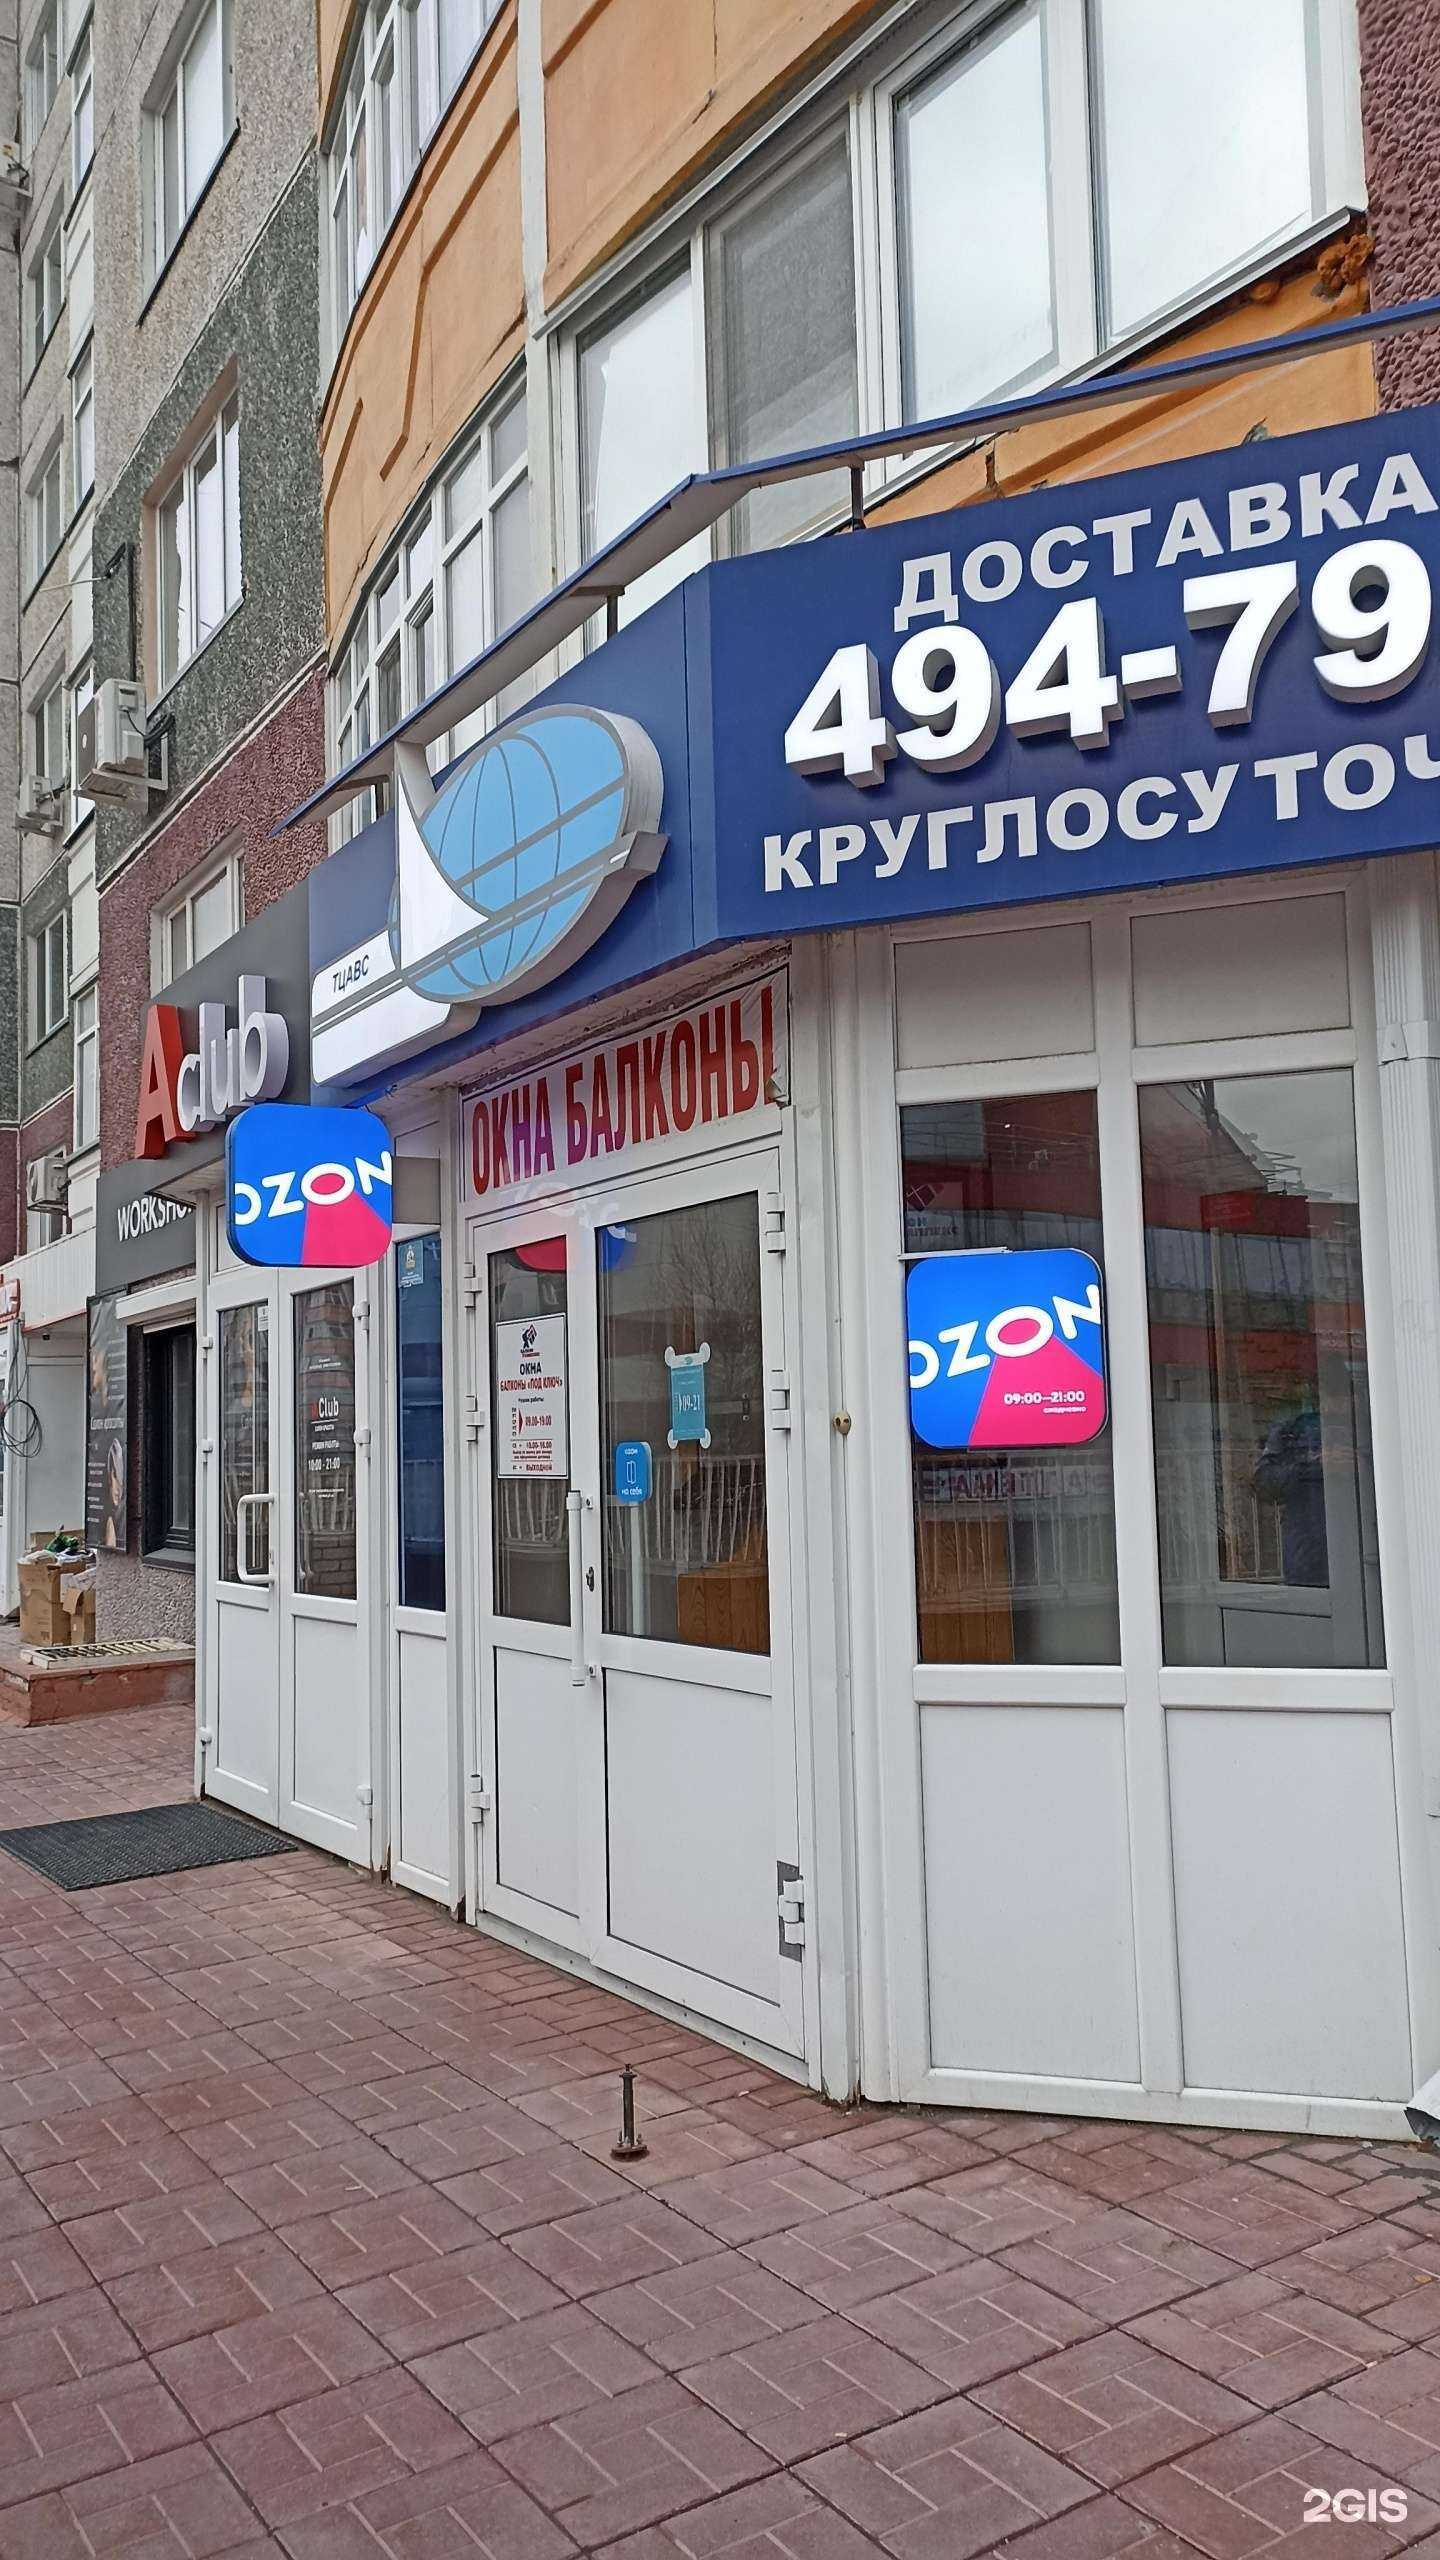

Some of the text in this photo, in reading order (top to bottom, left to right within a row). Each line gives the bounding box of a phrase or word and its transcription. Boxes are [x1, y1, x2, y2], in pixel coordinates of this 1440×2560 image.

[894, 453, 1439, 632] ДОСТАВКА
[784, 539, 1433, 786] 494-79
[333, 955, 369, 992] ТЦАВС
[472, 986, 774, 1194] ОКНА БАЛКОНЫ
[118, 1196, 192, 1242] WORKSH
[235, 1151, 392, 1225] OZON
[520, 1362, 541, 1375] ОКНА
[908, 1284, 1101, 1388] OZON
